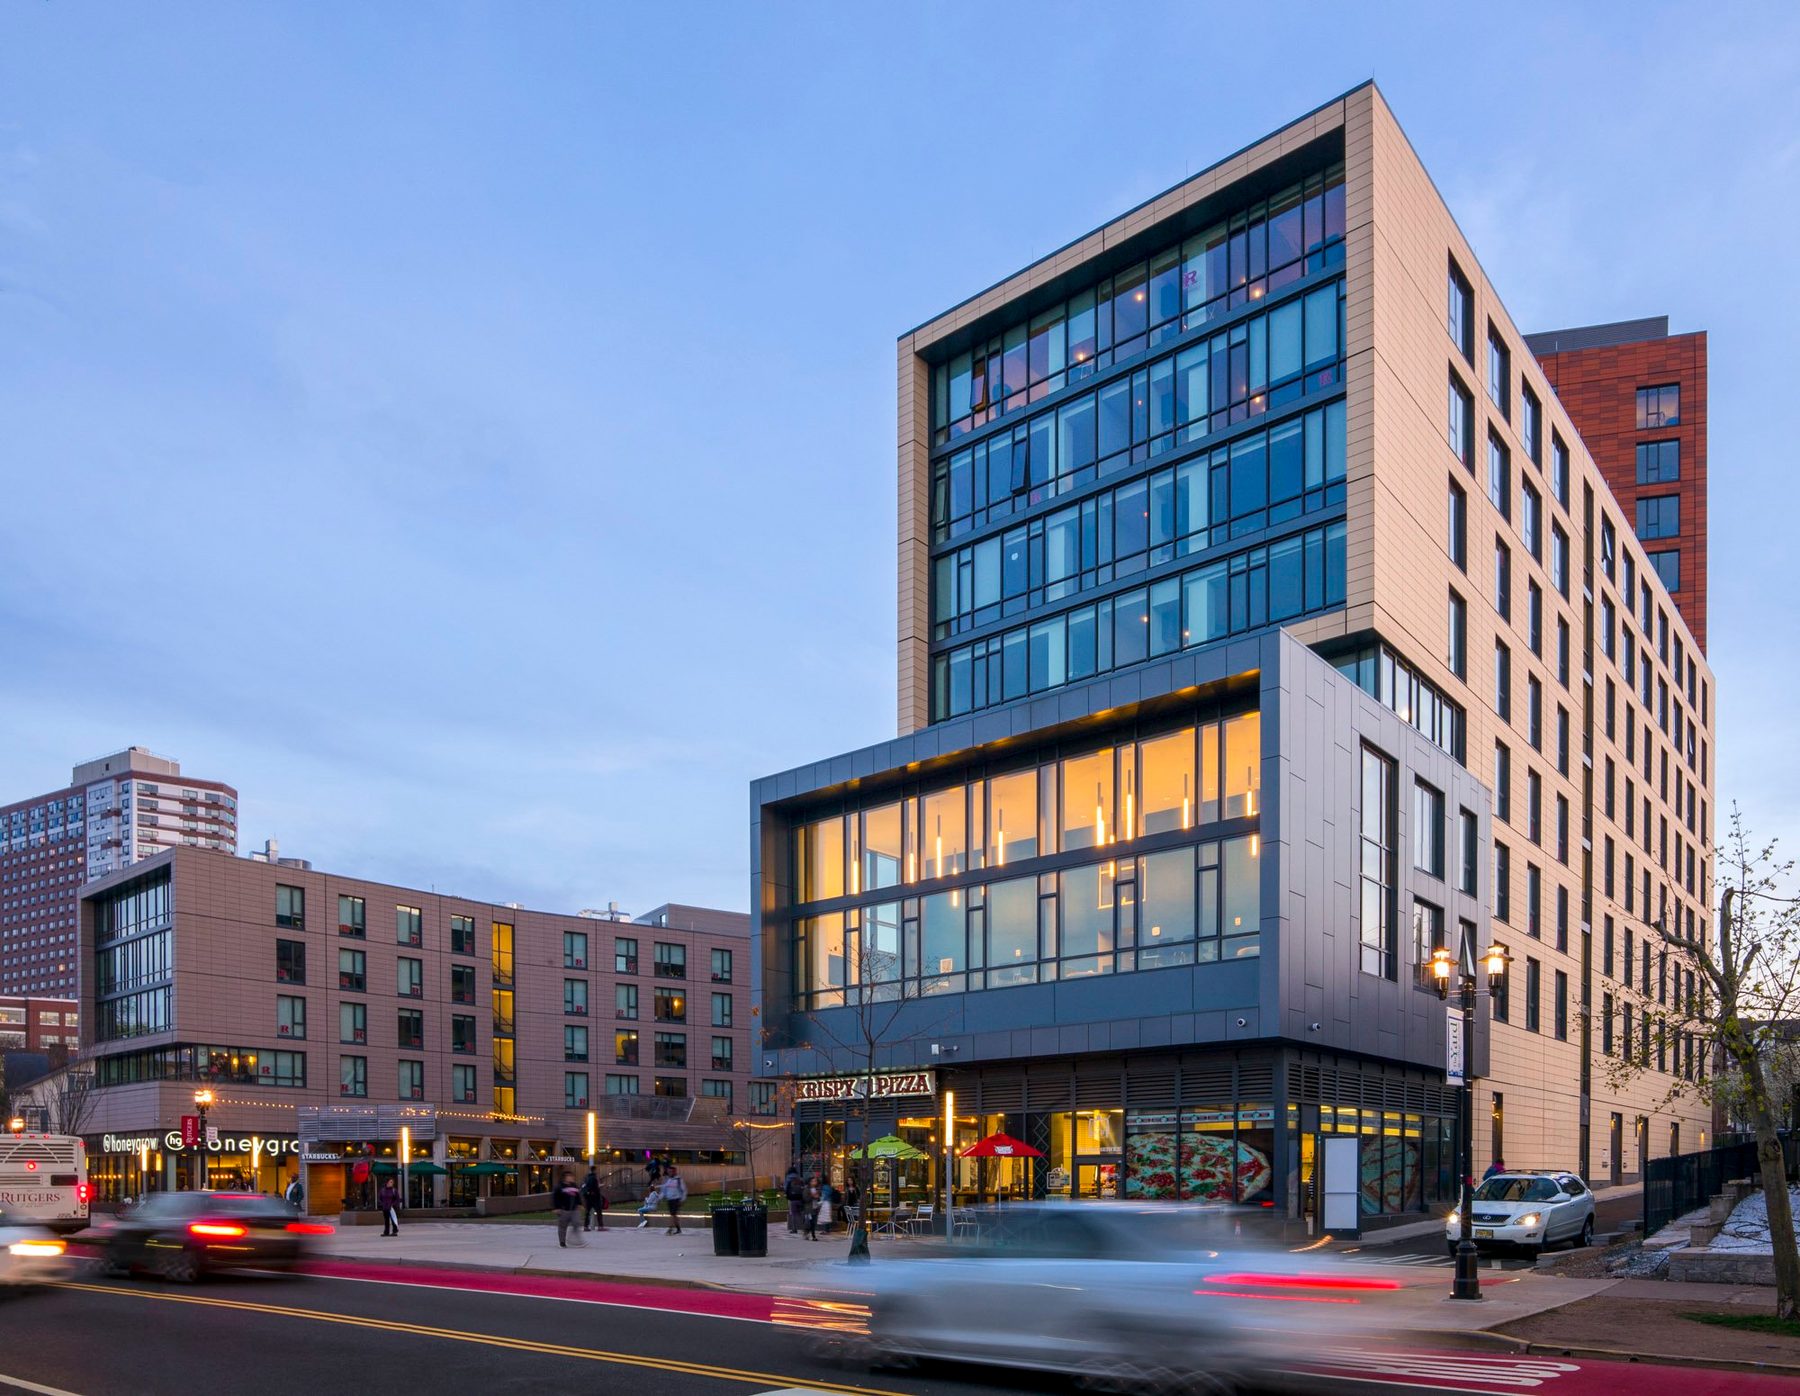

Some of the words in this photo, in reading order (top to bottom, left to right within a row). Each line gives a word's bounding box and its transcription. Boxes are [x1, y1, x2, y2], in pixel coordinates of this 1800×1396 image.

[1183, 270, 1197, 288] R
[281, 1025, 289, 1034] R
[262, 1066, 271, 1075] R
[796, 1079, 857, 1100] KRISPY
[877, 1074, 930, 1095] PIZZA
[186, 1118, 194, 1143] RUTGERS
[1, 1192, 61, 1206] RUTGERS
